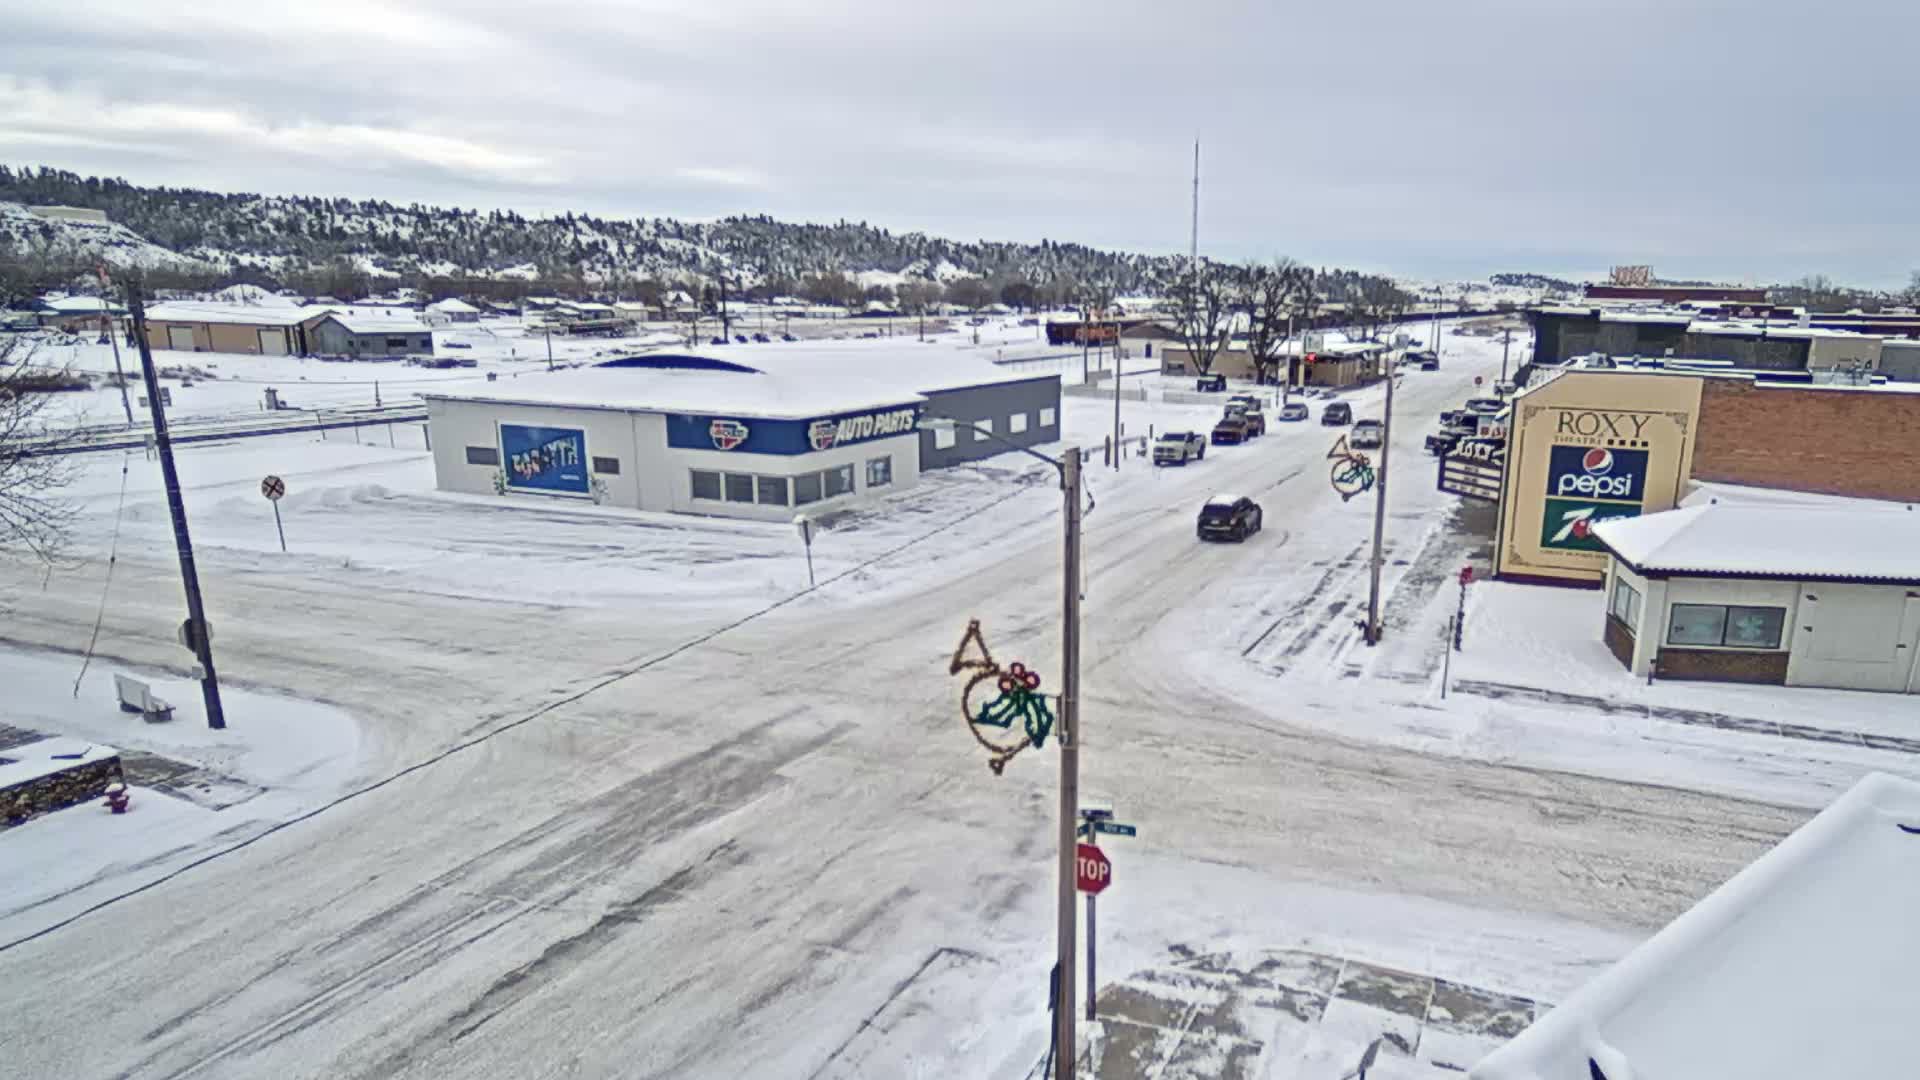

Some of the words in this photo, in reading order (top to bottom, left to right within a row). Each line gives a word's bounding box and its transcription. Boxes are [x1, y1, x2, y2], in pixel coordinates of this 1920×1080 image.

[836, 418, 873, 446] AUTO
[873, 409, 915, 436] PARTS
[1558, 411, 1651, 438] ROXY
[1558, 473, 1633, 498] pepsi
[1078, 857, 1109, 881] TOP
